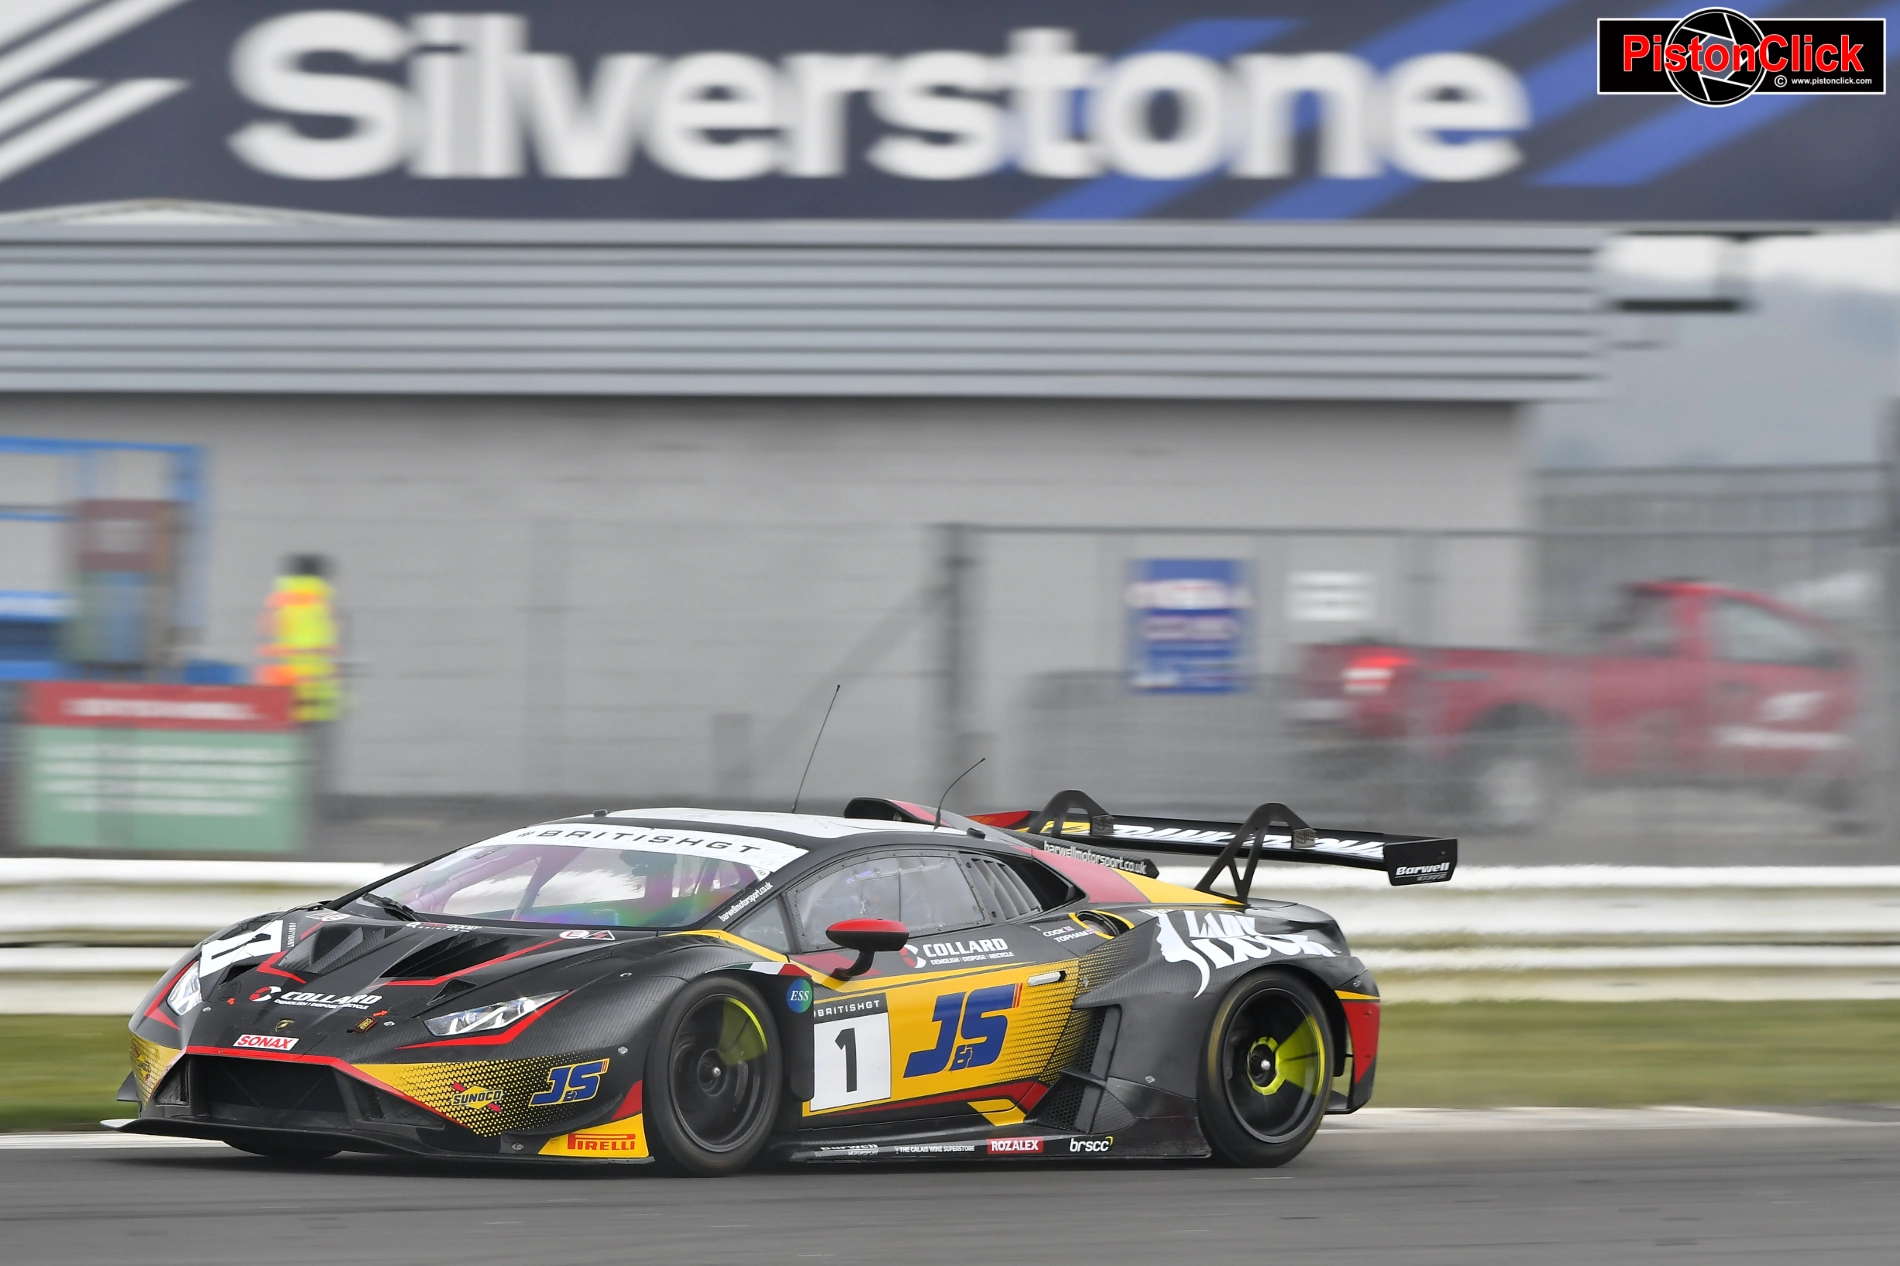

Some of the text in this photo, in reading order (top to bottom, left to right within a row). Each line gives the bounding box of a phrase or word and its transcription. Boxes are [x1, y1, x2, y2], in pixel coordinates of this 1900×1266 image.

[226, 10, 1532, 181] Silverstone
[1043, 840, 1148, 875] barwellmotorsport.co.uk
[1395, 862, 1451, 876] Barwell
[1043, 928, 1067, 937] COOK
[922, 938, 1009, 958] COLLARD
[280, 991, 383, 1005] COLLARD
[789, 990, 810, 1001] ESS
[237, 1035, 293, 1050] SONAX
[834, 1027, 858, 1093] 1
[453, 1090, 502, 1105] SUNOCO
[567, 1133, 636, 1151] PIRELLI
[991, 1140, 1040, 1151] ROZALEX
[1069, 1138, 1110, 1152] brscc
